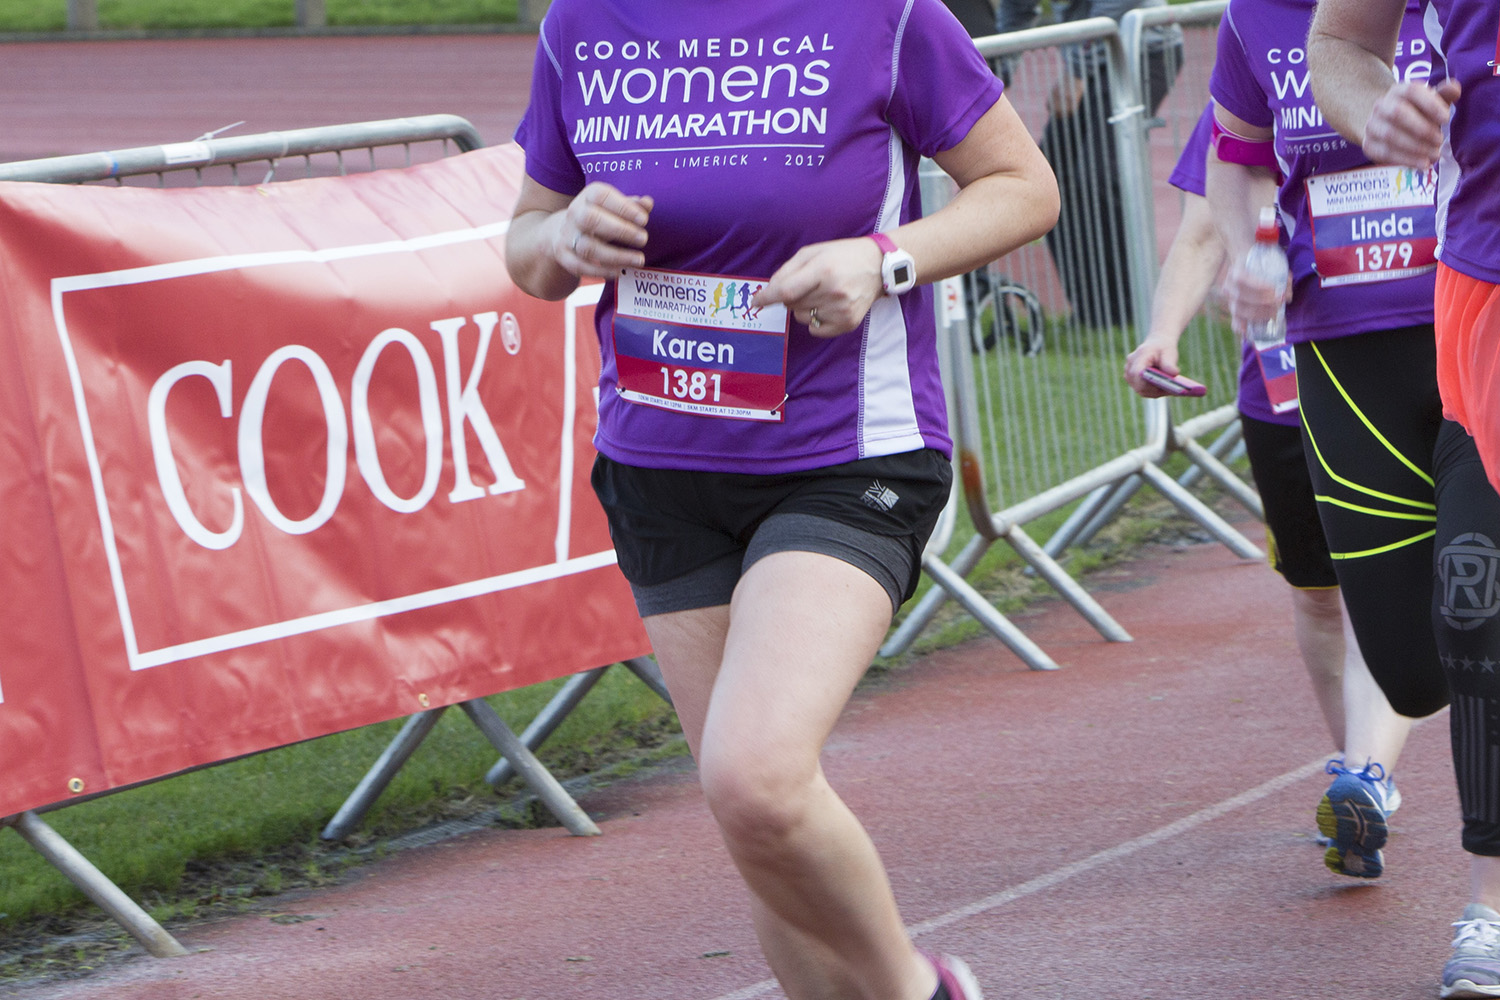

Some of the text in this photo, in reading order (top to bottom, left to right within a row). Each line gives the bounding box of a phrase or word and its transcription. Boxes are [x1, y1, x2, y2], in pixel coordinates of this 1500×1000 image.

[575, 33, 834, 61] COOK MEDICAL
[577, 59, 831, 106] womens
[573, 107, 827, 144] MINI MARATHON
[1281, 105, 1323, 130] MINI
[586, 159, 642, 173] OCTOBER
[674, 154, 749, 169] LIMERICK
[785, 154, 825, 167] 2017
[1325, 178, 1390, 195] womens
[1326, 191, 1391, 205] MINI MARATHON
[1351, 213, 1414, 241] Linda
[1355, 242, 1413, 272] 1379
[634, 271, 708, 287] COOK MEDICAL
[635, 280, 707, 302] womens
[634, 296, 706, 315] MINI MARATHON
[685, 317, 723, 326] LIMERICK
[742, 321, 763, 329] 2017
[653, 329, 735, 365] Karen
[660, 367, 722, 402] 1381
